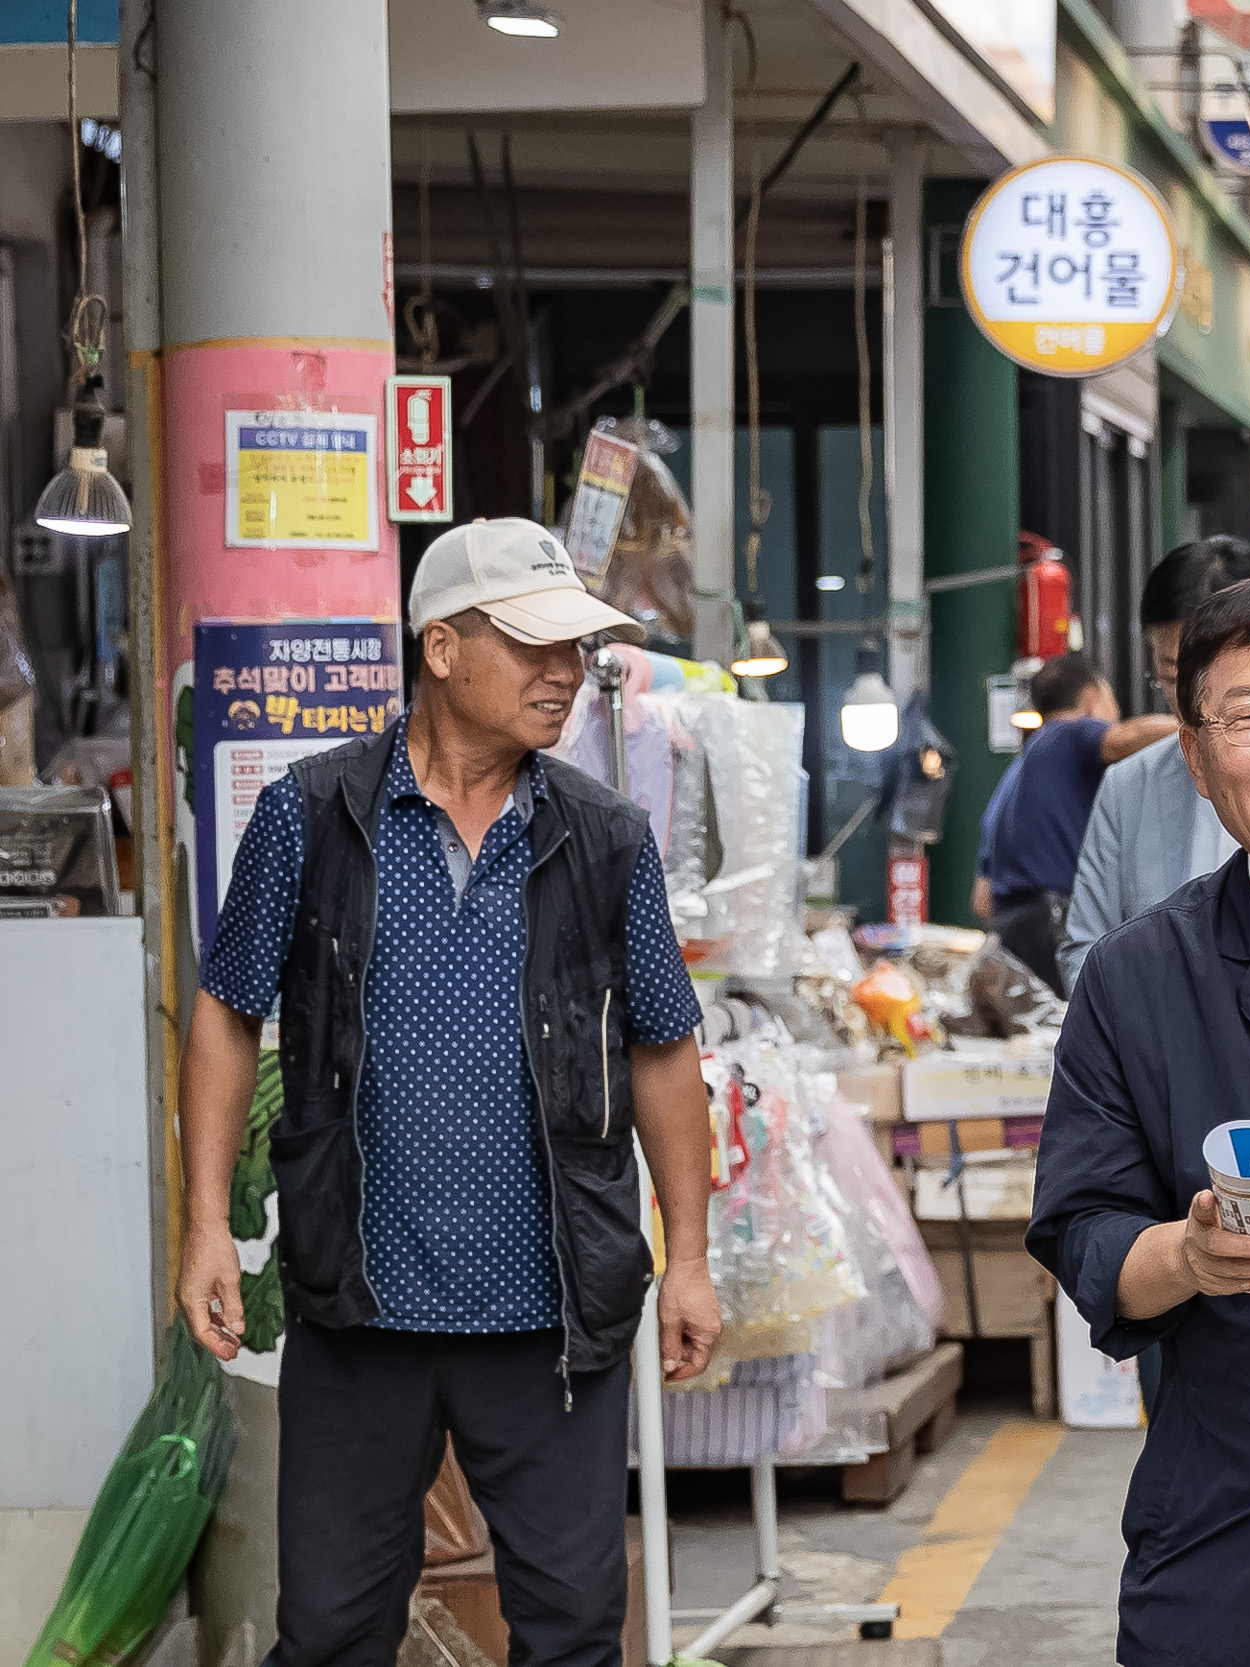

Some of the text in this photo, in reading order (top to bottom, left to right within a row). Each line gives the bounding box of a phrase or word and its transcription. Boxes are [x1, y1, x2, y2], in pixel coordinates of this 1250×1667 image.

[1021, 190, 1120, 248] 대흥
[995, 252, 1146, 308] 건어물
[255, 430, 298, 447] CCTV
[269, 637, 382, 663] 자양전통시장
[213, 665, 316, 695] 추석맞이
[265, 695, 300, 735] 박
